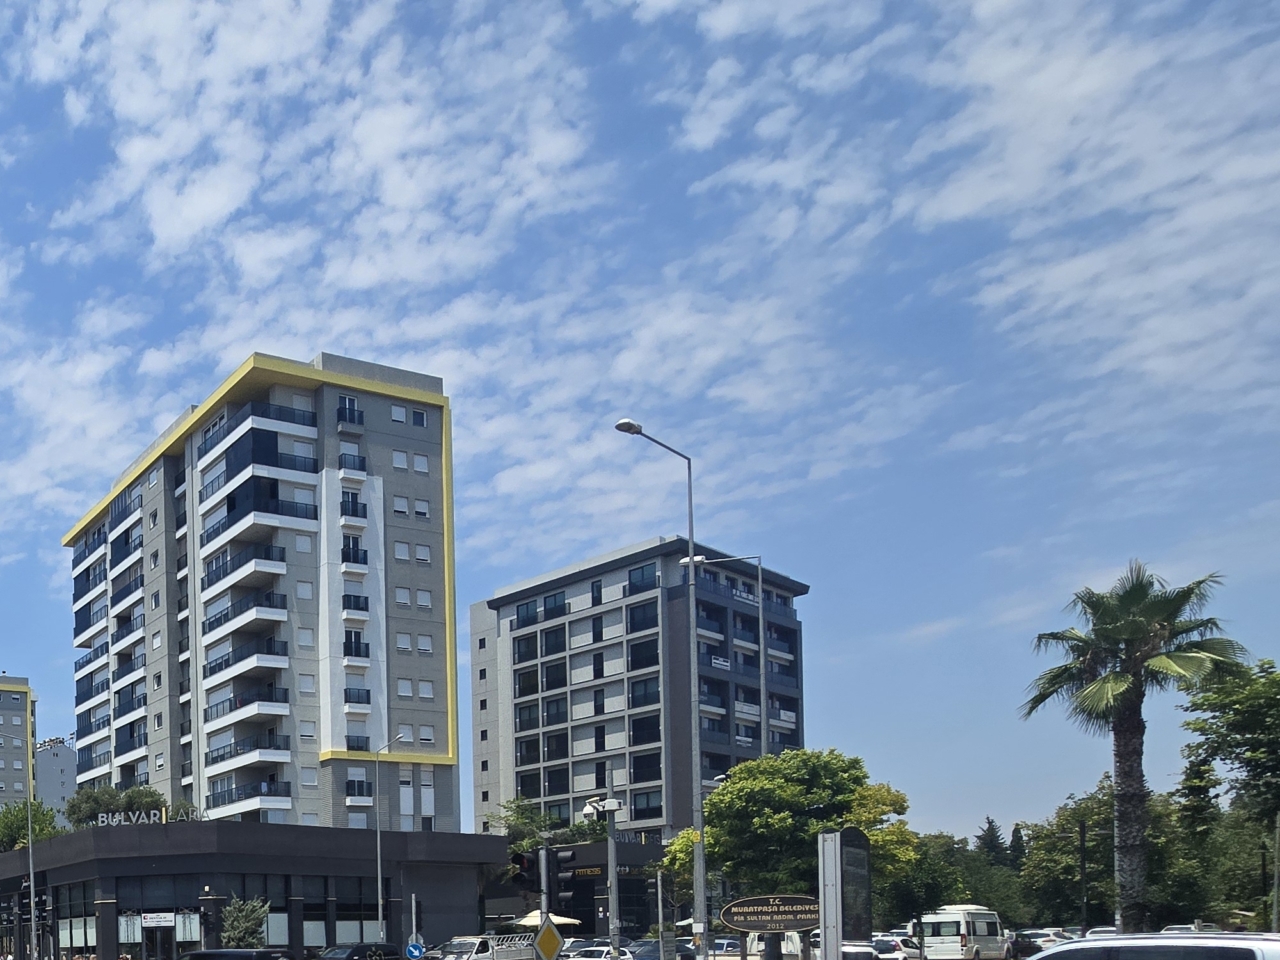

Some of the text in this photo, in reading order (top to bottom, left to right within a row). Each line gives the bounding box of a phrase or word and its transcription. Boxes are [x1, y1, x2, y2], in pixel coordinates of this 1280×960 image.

[97, 807, 211, 827] BULVAR LARA
[779, 904, 819, 912] BELEDİYES
